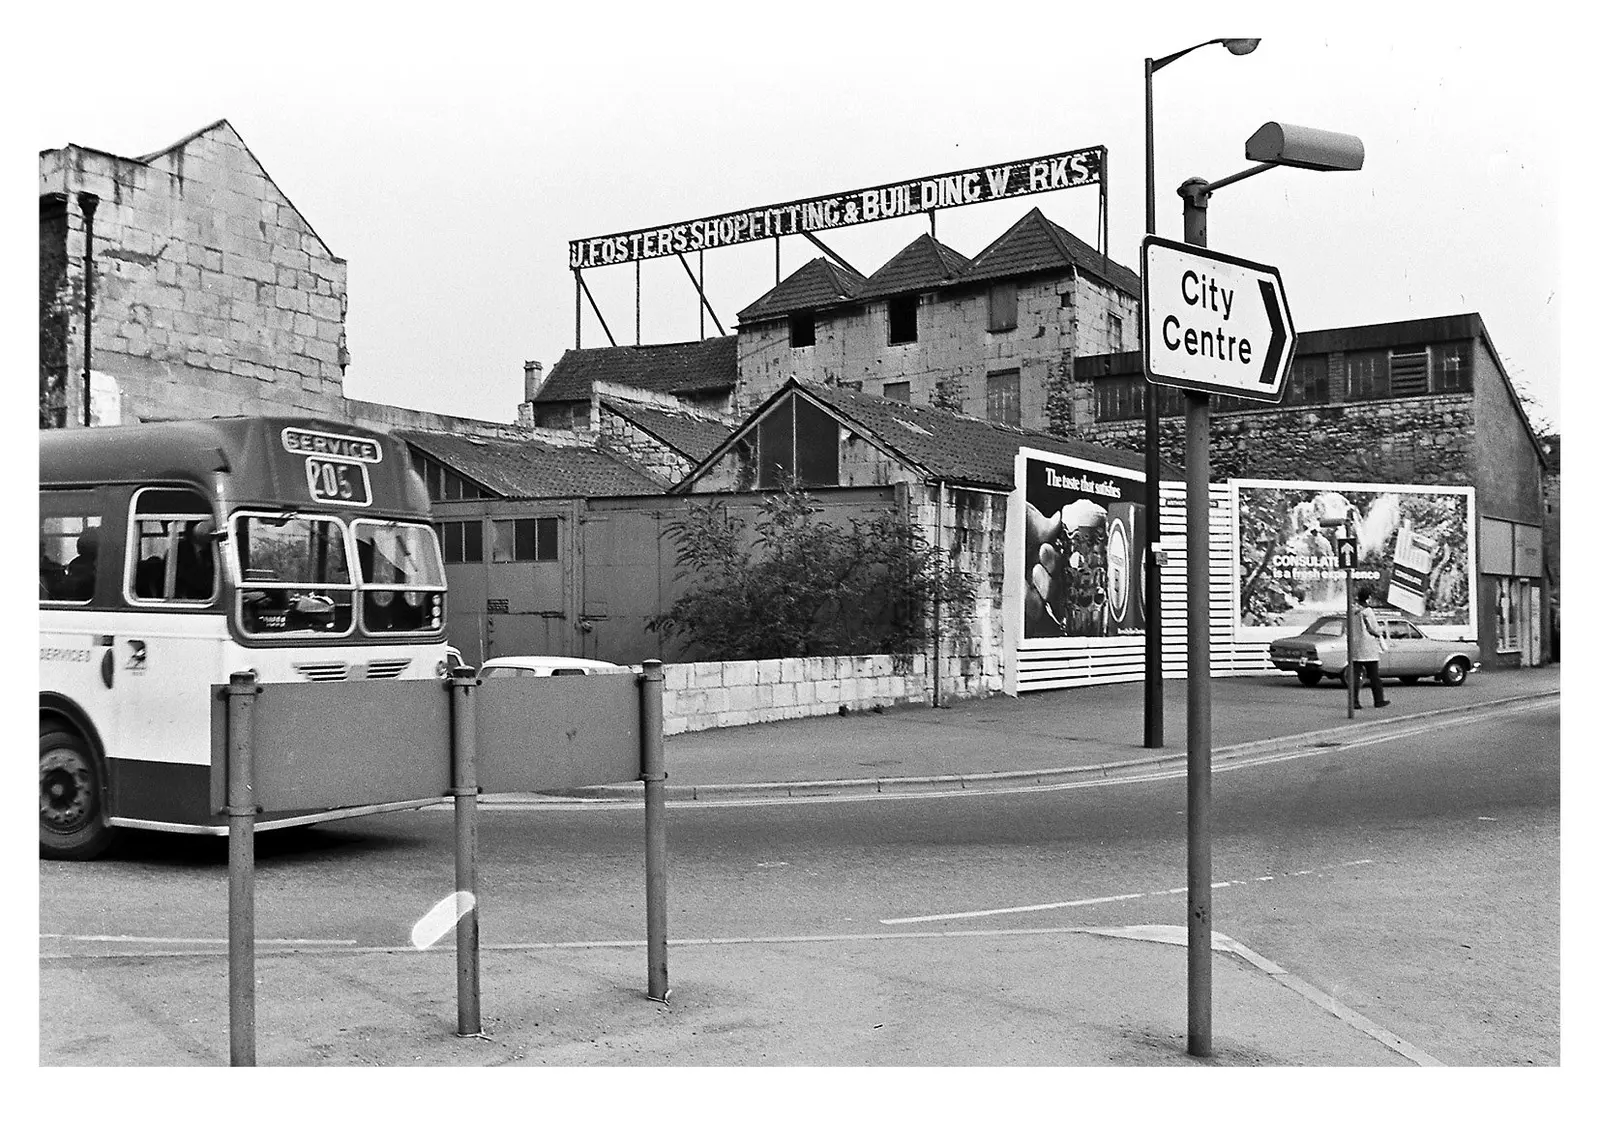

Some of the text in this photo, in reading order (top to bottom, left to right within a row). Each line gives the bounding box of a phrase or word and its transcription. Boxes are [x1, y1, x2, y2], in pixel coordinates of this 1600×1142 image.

[690, 199, 840, 250] SHOPFITTING
[843, 201, 859, 223] &
[859, 172, 981, 221] BUILDING
[985, 153, 1100, 198] WRKS.
[1181, 269, 1234, 321] City
[1162, 314, 1252, 364] Centre
[287, 432, 374, 459] SERVICE
[309, 461, 353, 498] 205
[1045, 467, 1061, 487] The
[1062, 475, 1080, 490] taste
[1080, 474, 1094, 493] that
[1273, 567, 1283, 579] is
[1283, 570, 1291, 579] a
[1320, 567, 1381, 581] expeience
